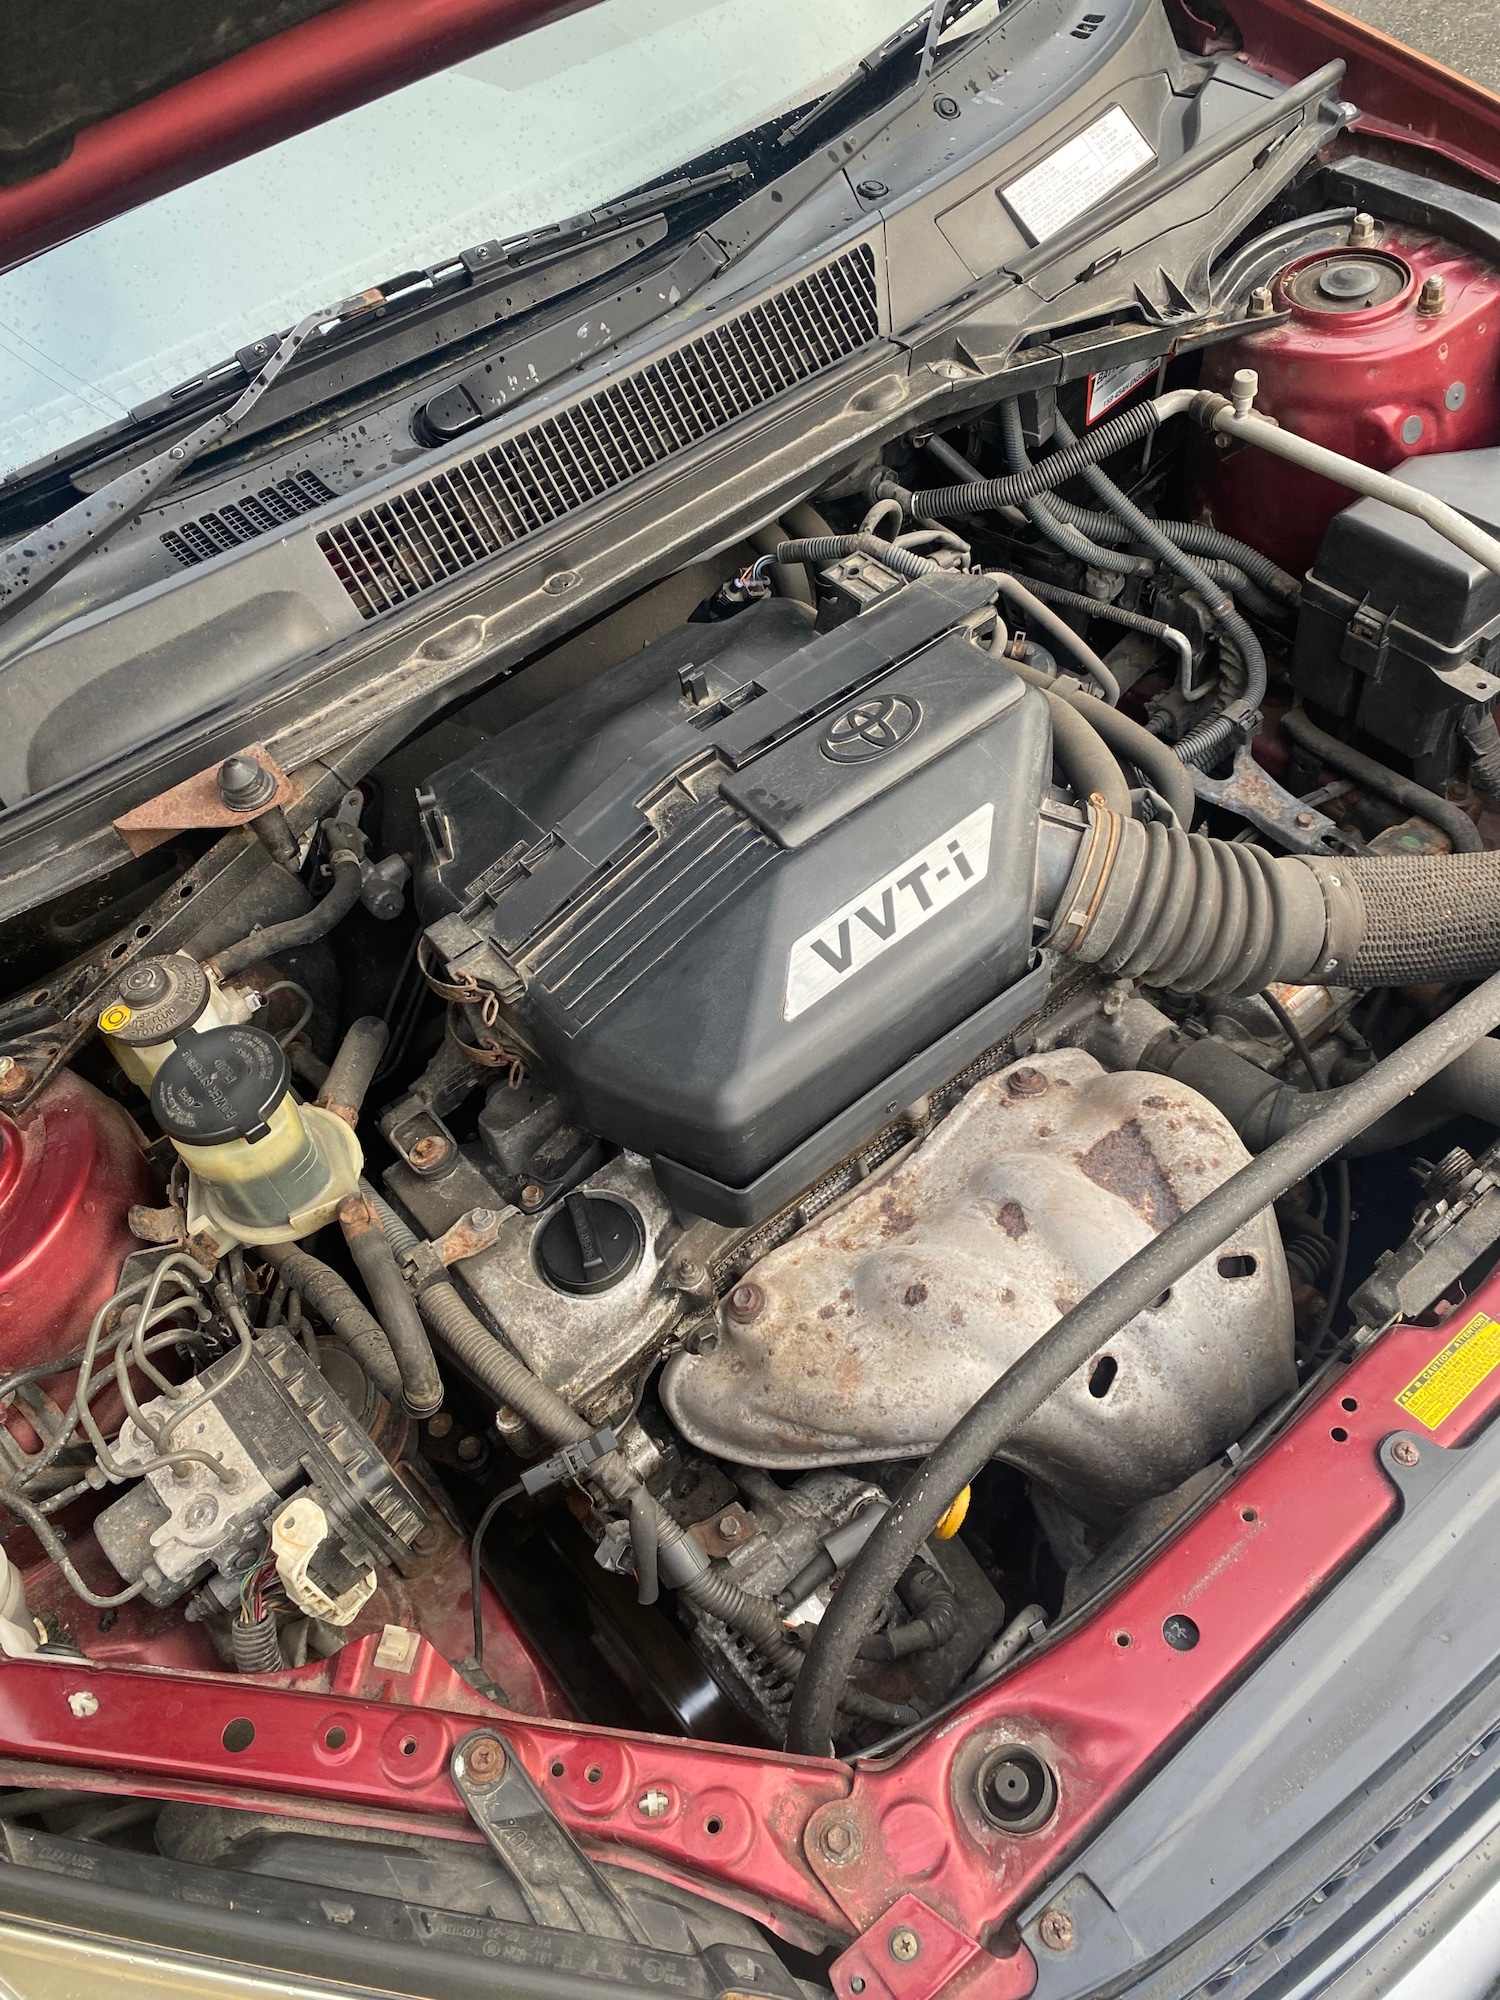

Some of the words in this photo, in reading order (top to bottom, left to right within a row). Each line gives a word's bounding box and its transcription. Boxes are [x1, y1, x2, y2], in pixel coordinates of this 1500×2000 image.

[810, 839, 975, 974] VVT-i
[153, 1006, 177, 1024] FLUID
[180, 1048, 214, 1089] STEERING
[212, 1056, 237, 1084] FLUID
[206, 1085, 238, 1121] POWER
[1423, 1349, 1453, 1379] CAUTION
[1454, 1315, 1486, 1348] ATTENTION
